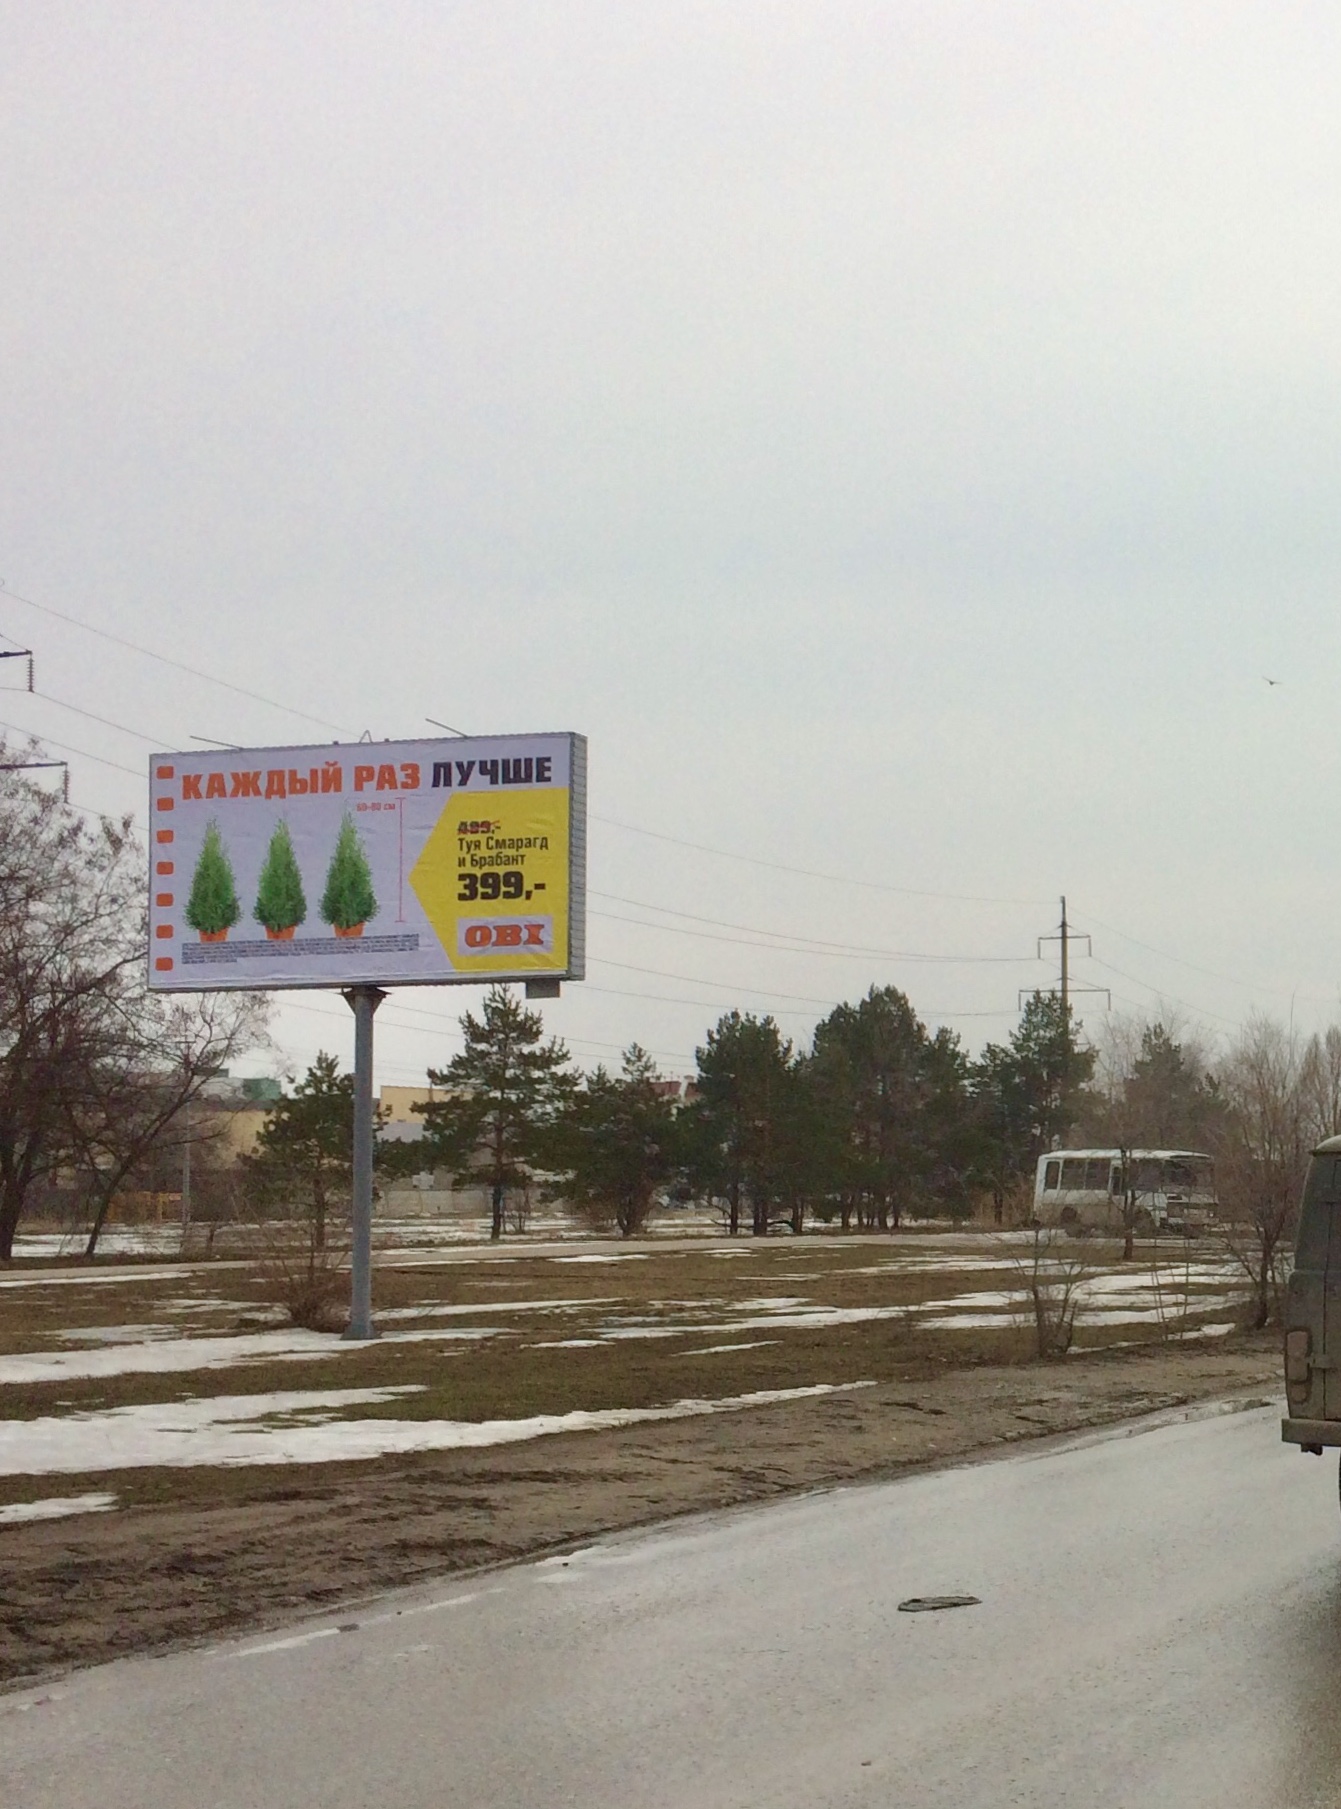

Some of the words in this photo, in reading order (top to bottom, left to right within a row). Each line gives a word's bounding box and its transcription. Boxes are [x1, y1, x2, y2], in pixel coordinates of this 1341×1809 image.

[182, 761, 342, 800] КАЖДЫЙ
[354, 763, 420, 792] РАЗ
[431, 757, 552, 788] ЛУЧШЕ
[458, 838, 481, 854] Туя
[486, 836, 549, 852] Смарагд
[458, 857, 466, 868] и
[470, 852, 526, 870] Брабант
[457, 871, 546, 901] 399,-
[464, 924, 545, 948] OBI
